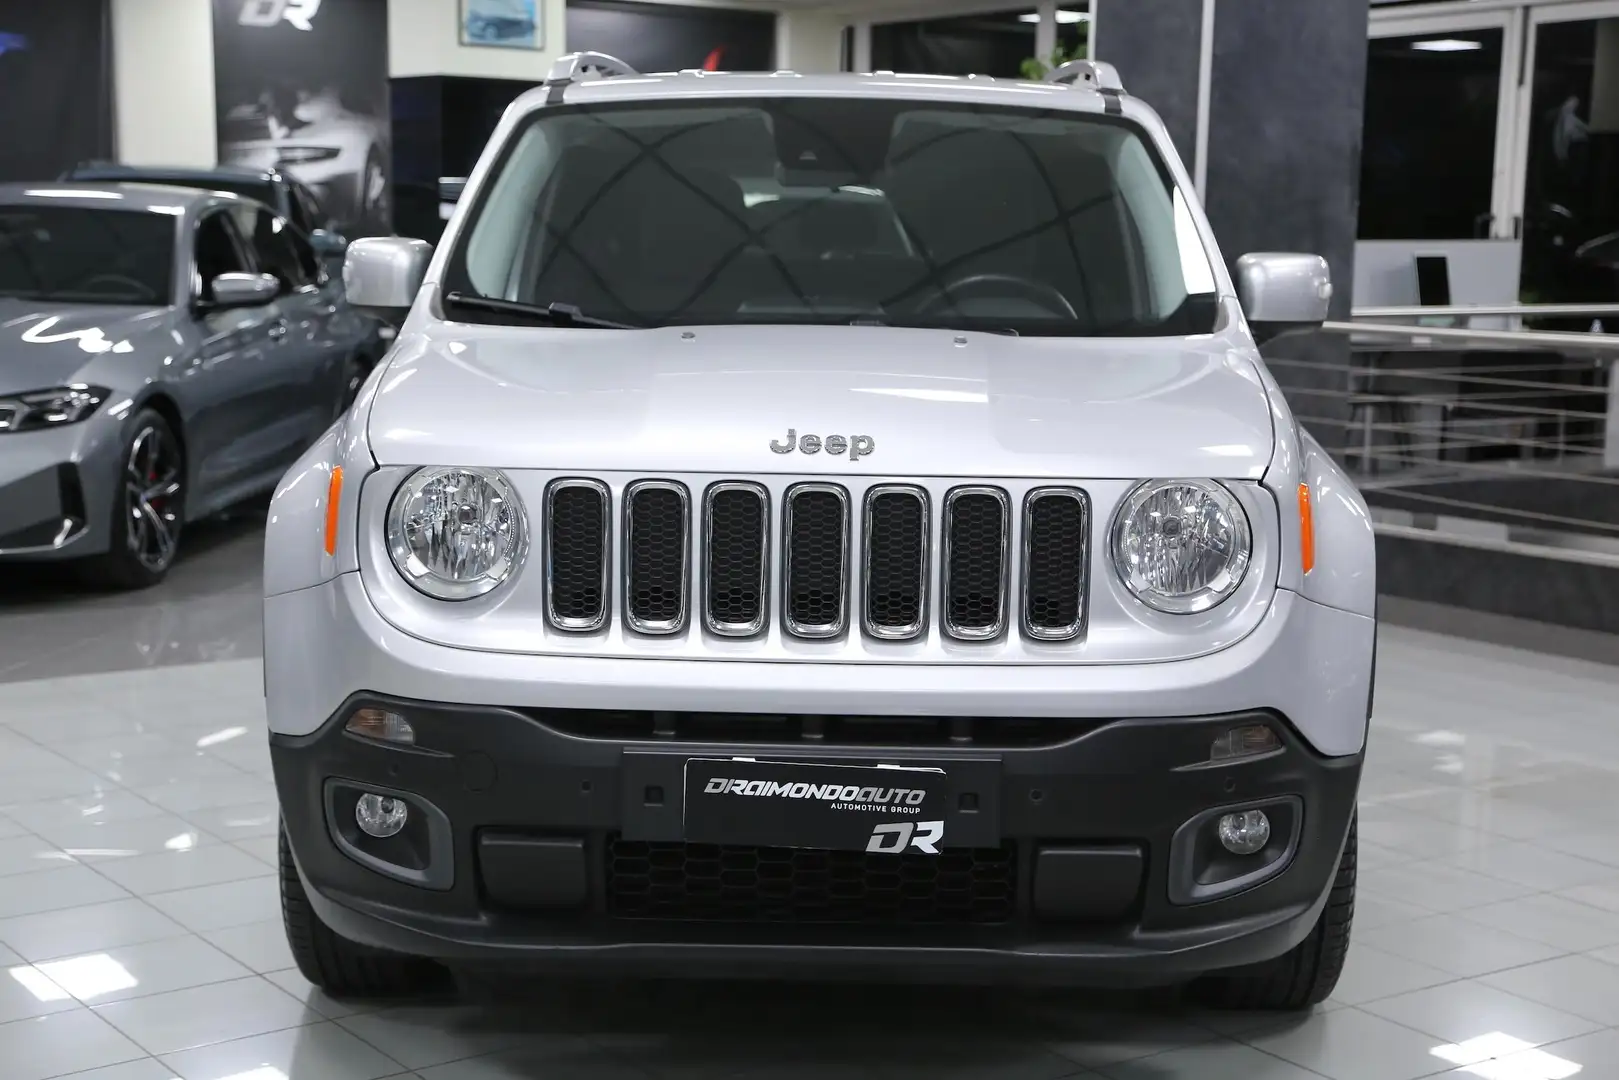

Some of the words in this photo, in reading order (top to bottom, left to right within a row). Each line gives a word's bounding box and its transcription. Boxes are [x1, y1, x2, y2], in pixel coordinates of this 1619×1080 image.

[769, 428, 876, 462] Jeep
[830, 803, 887, 812] AUTOMOTIVE
[891, 806, 921, 814] GROUP
[865, 820, 944, 854] DR
